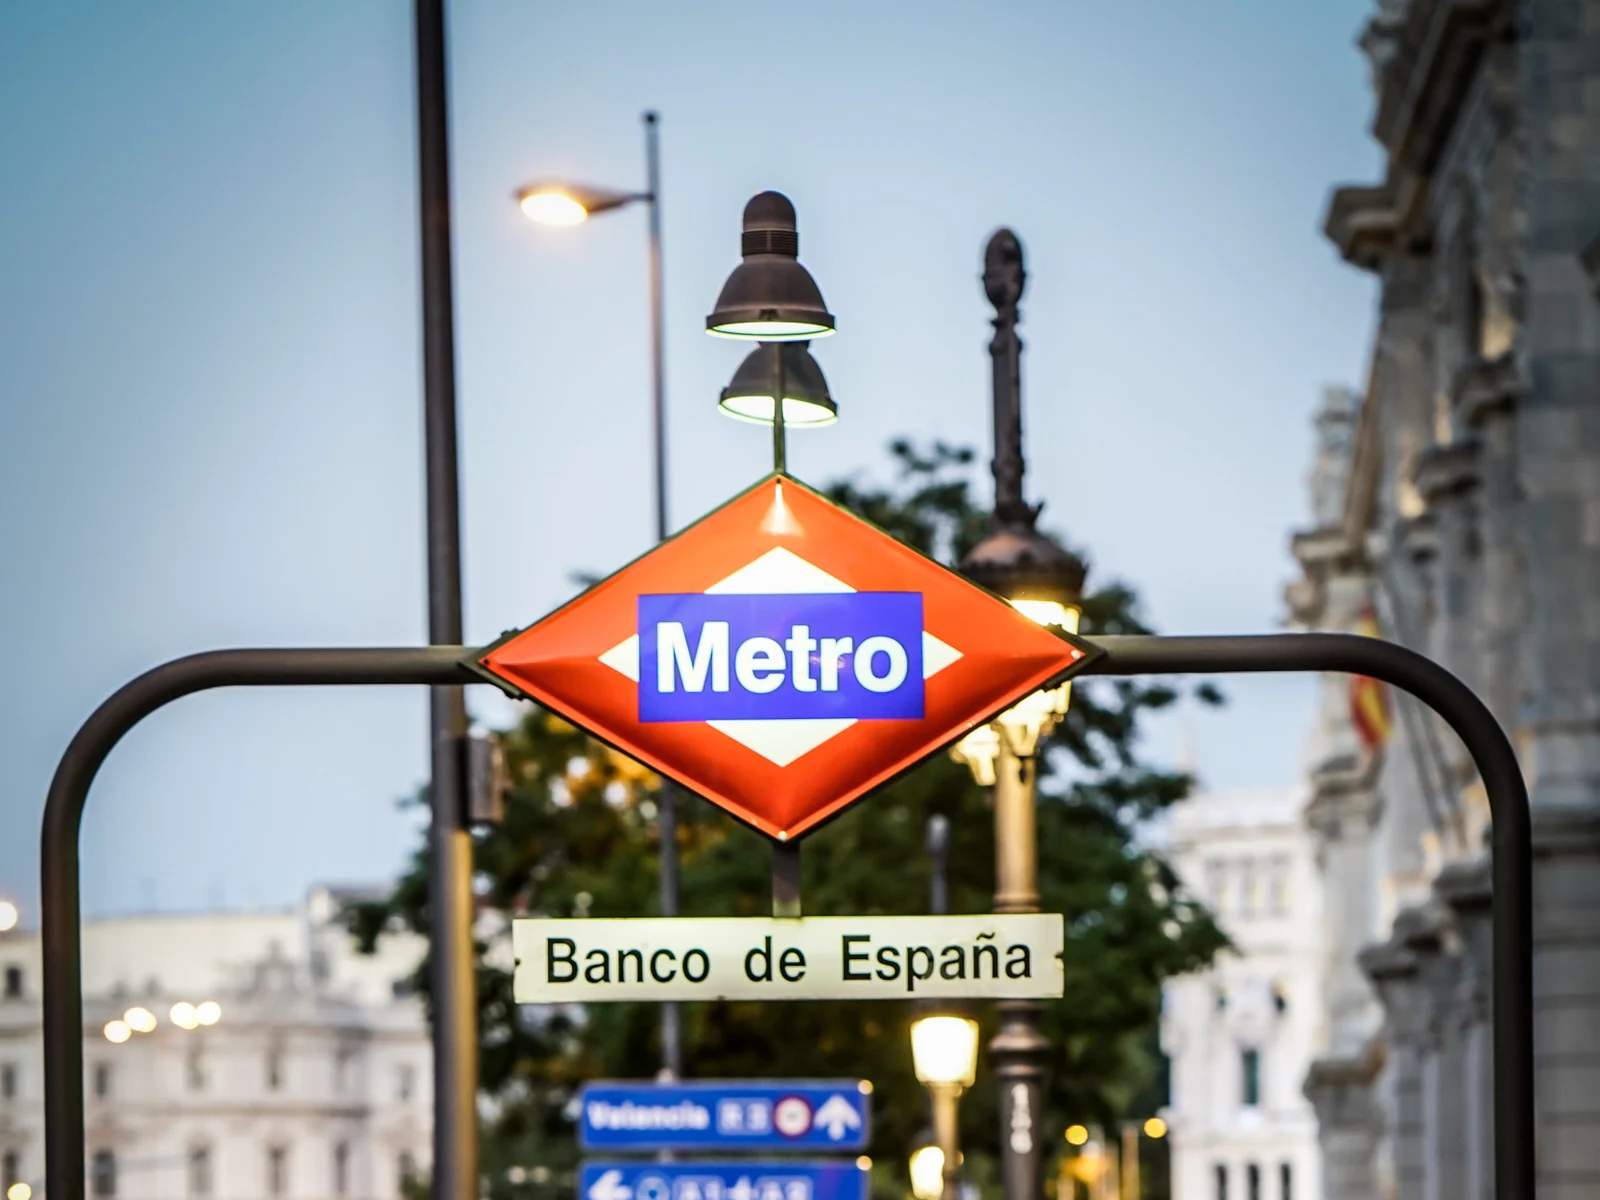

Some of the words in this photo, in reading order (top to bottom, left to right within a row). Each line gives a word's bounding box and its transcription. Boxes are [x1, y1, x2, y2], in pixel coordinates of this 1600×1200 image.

[656, 620, 909, 694] Metro
[546, 936, 711, 984] Banco
[744, 936, 807, 982] de
[843, 932, 1033, 992] España
